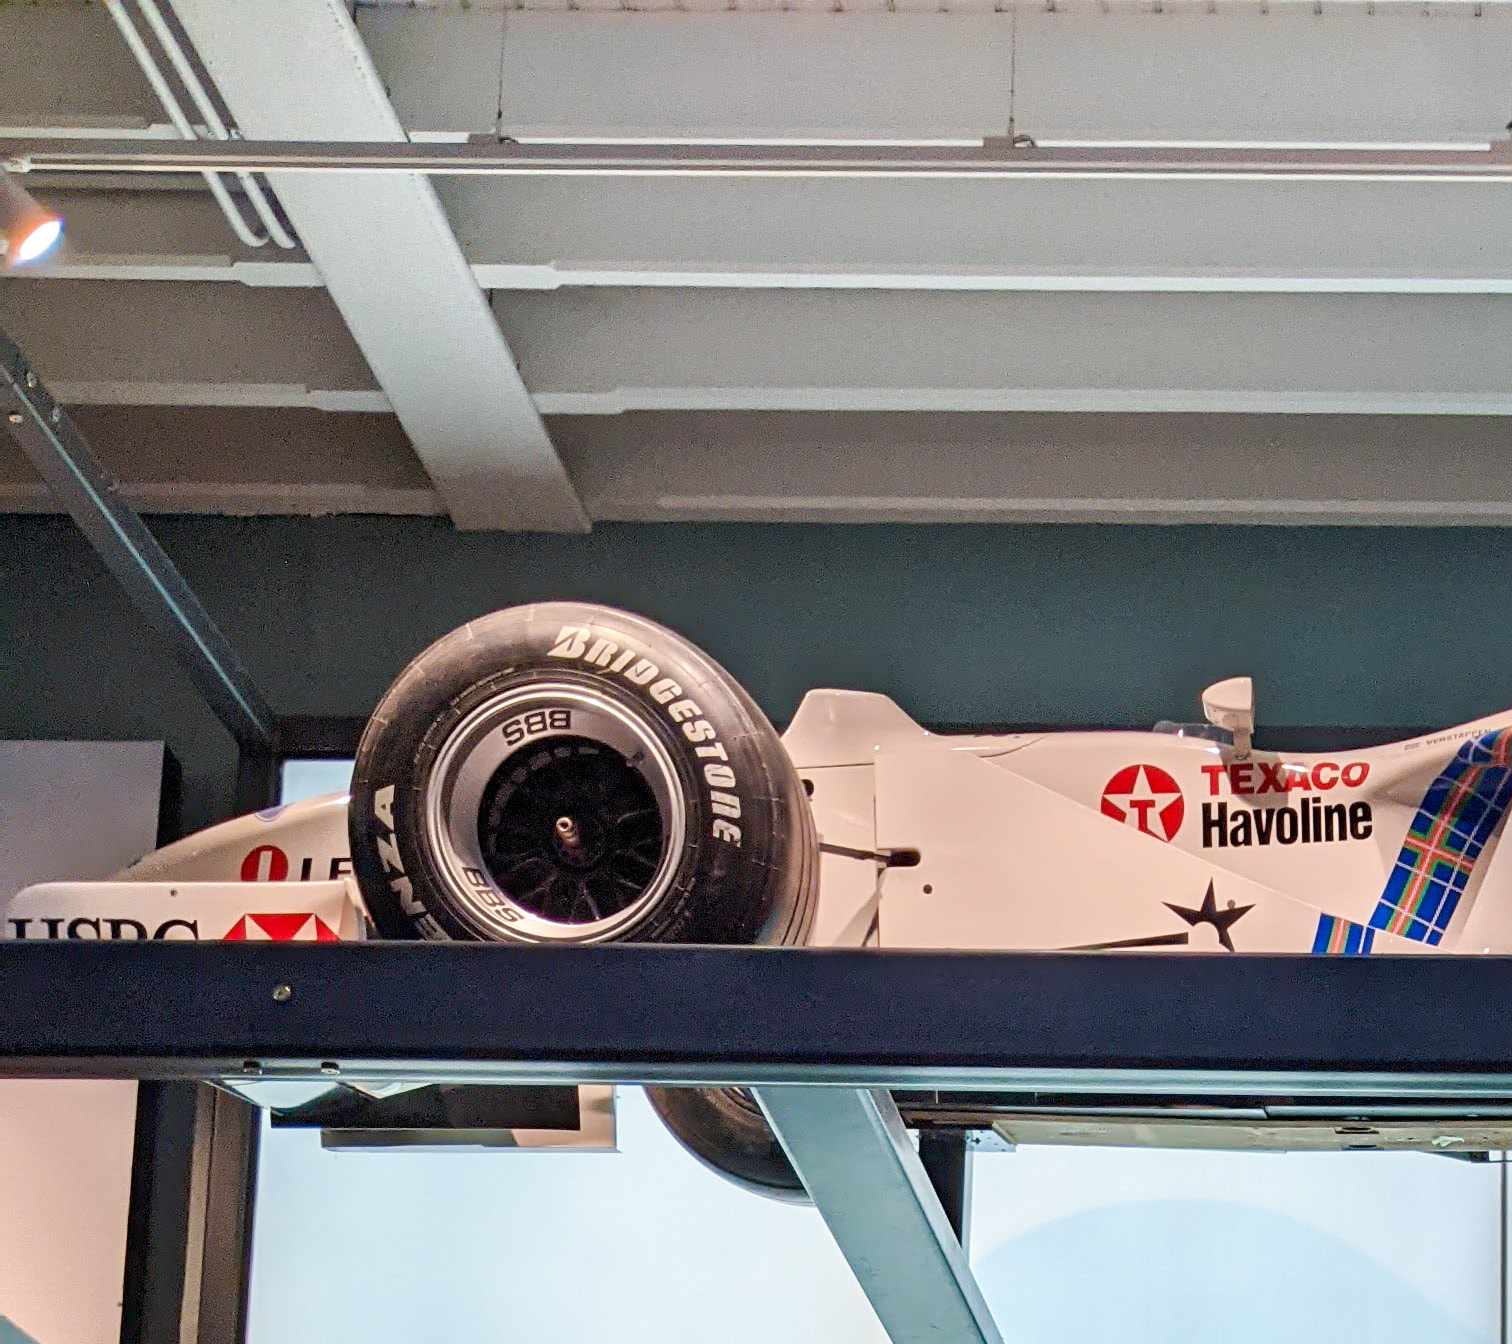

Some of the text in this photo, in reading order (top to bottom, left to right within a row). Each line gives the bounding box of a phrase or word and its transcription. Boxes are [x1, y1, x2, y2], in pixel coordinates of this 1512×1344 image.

[502, 709, 572, 747] BBS
[547, 625, 742, 849] BRIDGESTONE
[1200, 761, 1371, 797] TEXACO
[1201, 796, 1373, 849] Havoline
[461, 866, 525, 923] BBS
